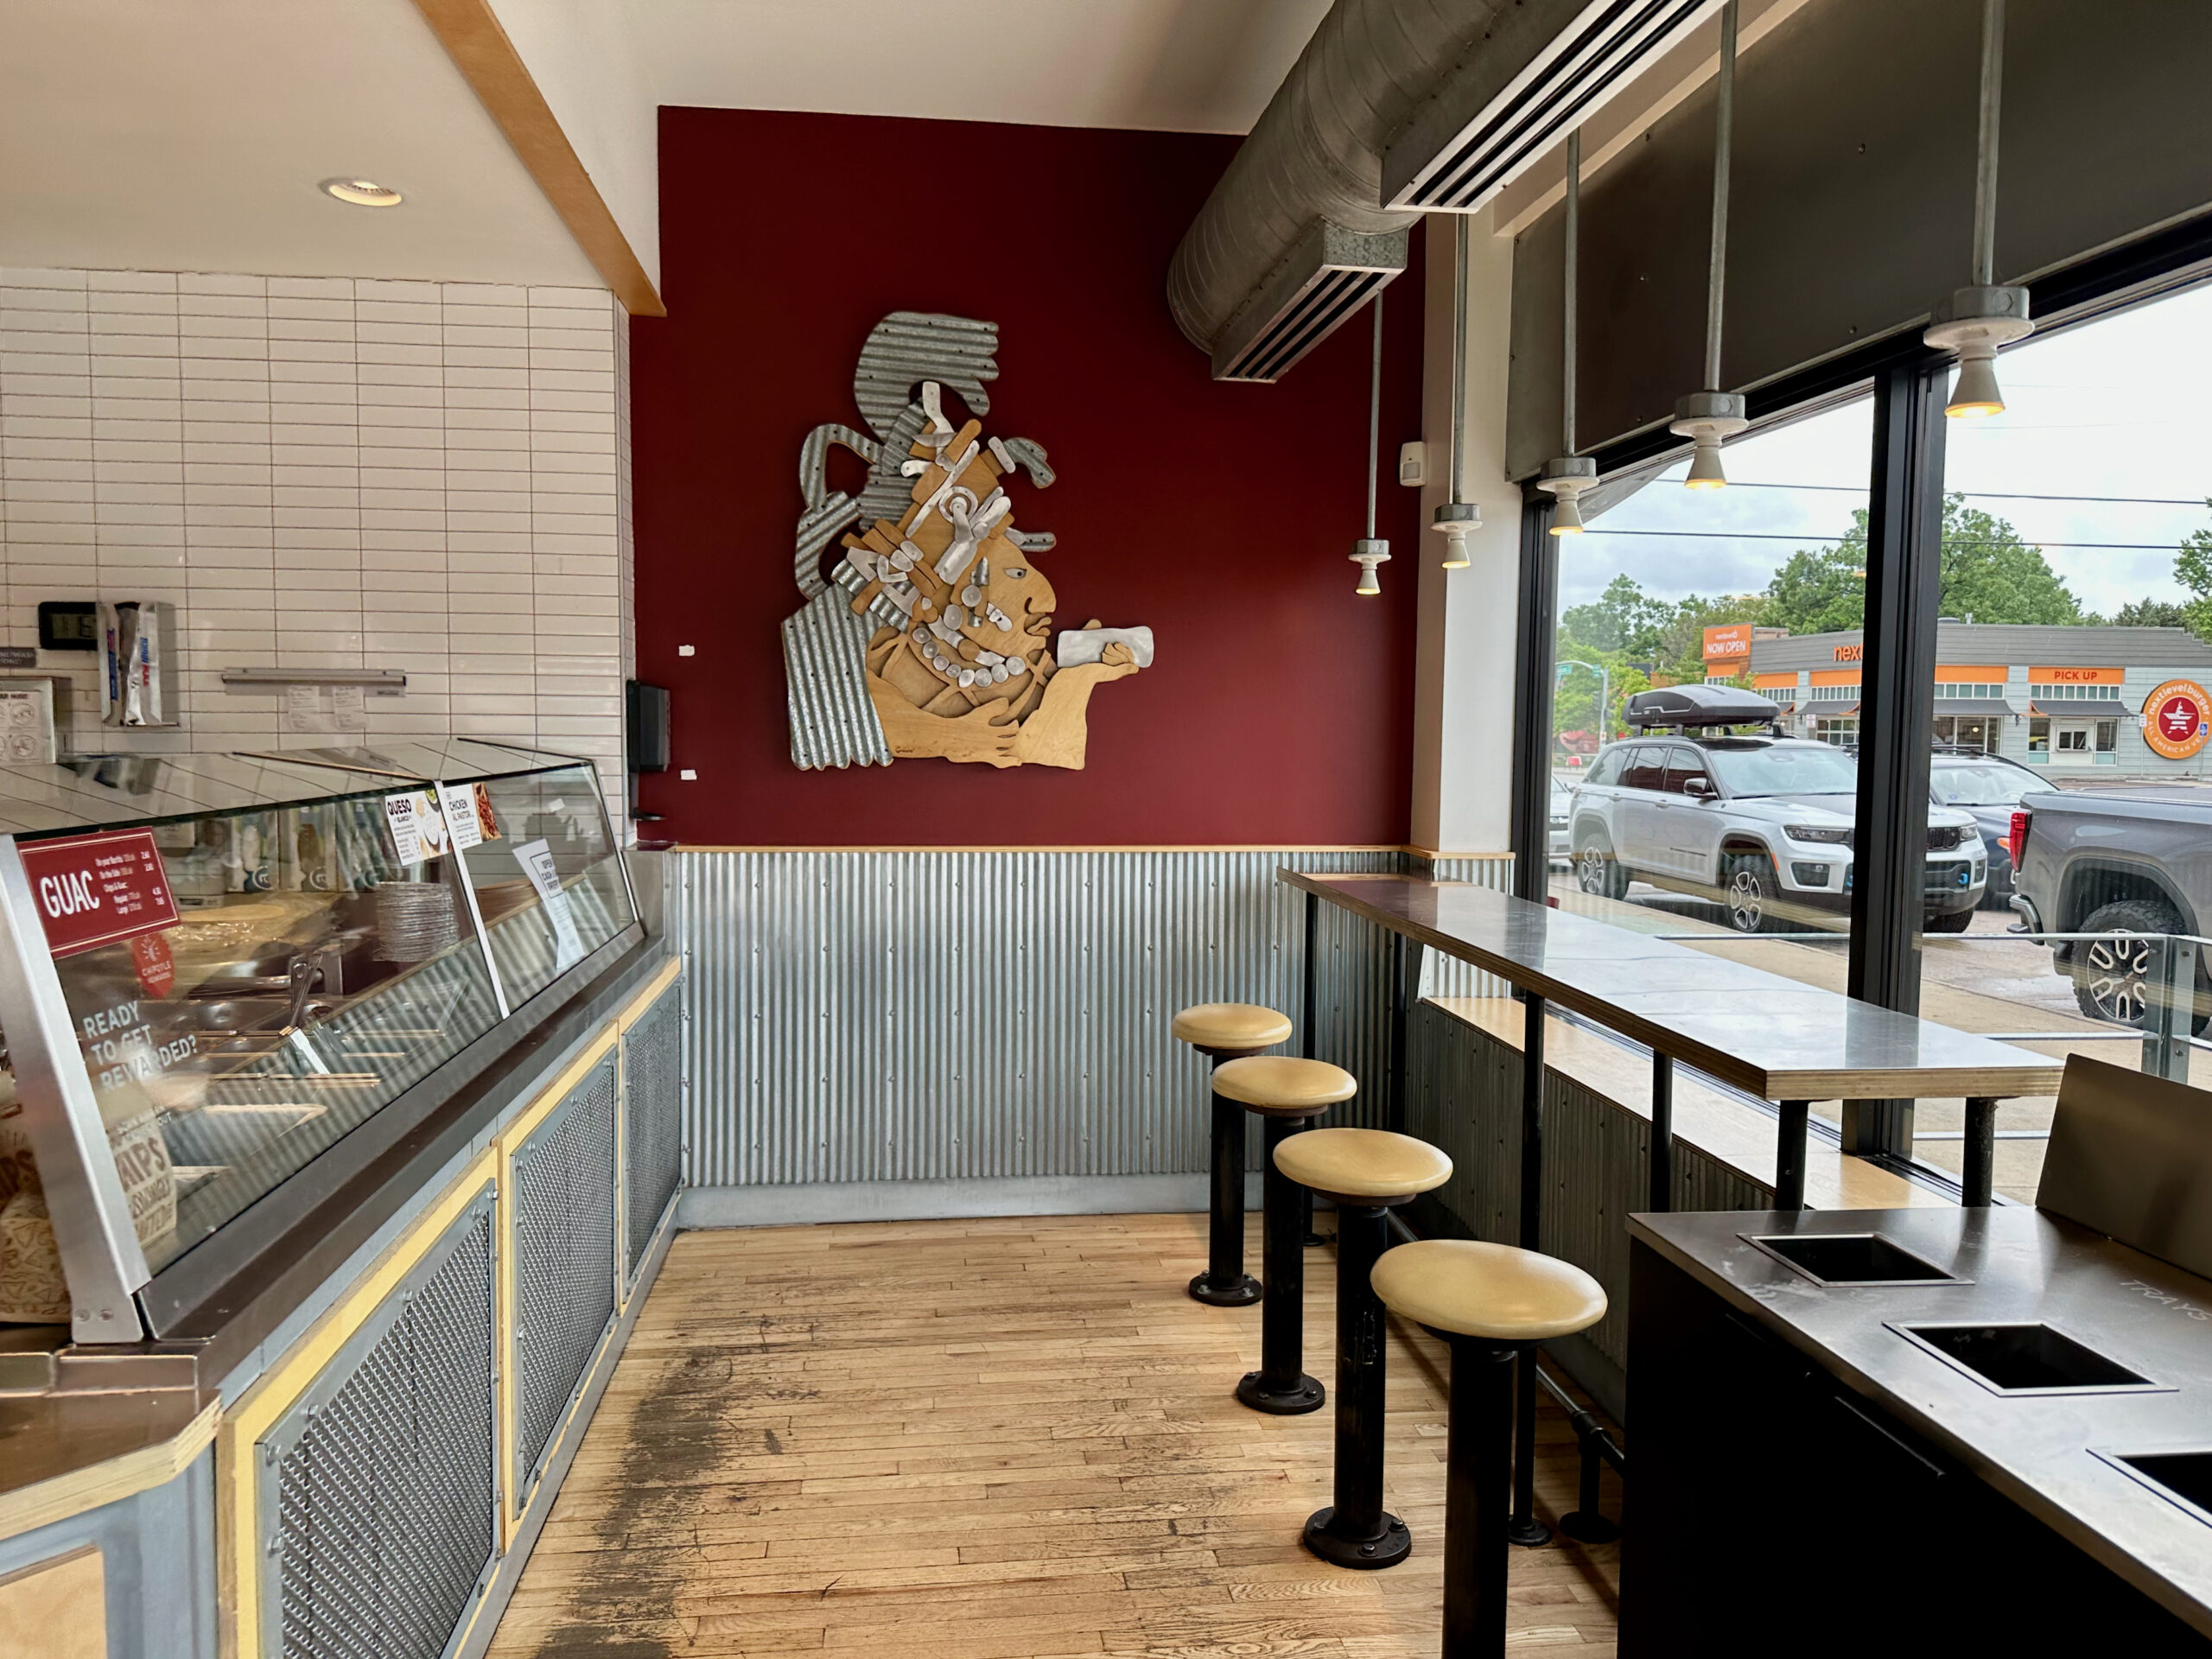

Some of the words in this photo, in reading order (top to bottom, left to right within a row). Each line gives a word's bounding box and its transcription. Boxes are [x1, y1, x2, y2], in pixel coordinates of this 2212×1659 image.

[1707, 643, 1725, 655] NOW
[1726, 641, 1746, 653] OPEN
[2054, 671, 2080, 680] PICK
[2082, 671, 2098, 681] UP
[2148, 683, 2210, 715] nextlevelburger
[2153, 737, 2191, 753] AMERICAN
[387, 798, 412, 816] QUESO
[448, 798, 468, 811] CHICKEN
[40, 869, 99, 918] GUAC
[142, 960, 171, 976] CHIPOTLE
[83, 1000, 139, 1039] READY
[91, 1039, 118, 1065] TO
[121, 1024, 152, 1051] GET
[99, 1034, 198, 1093] REWARDED?
[2119, 1279, 2212, 1321] TRAYS
